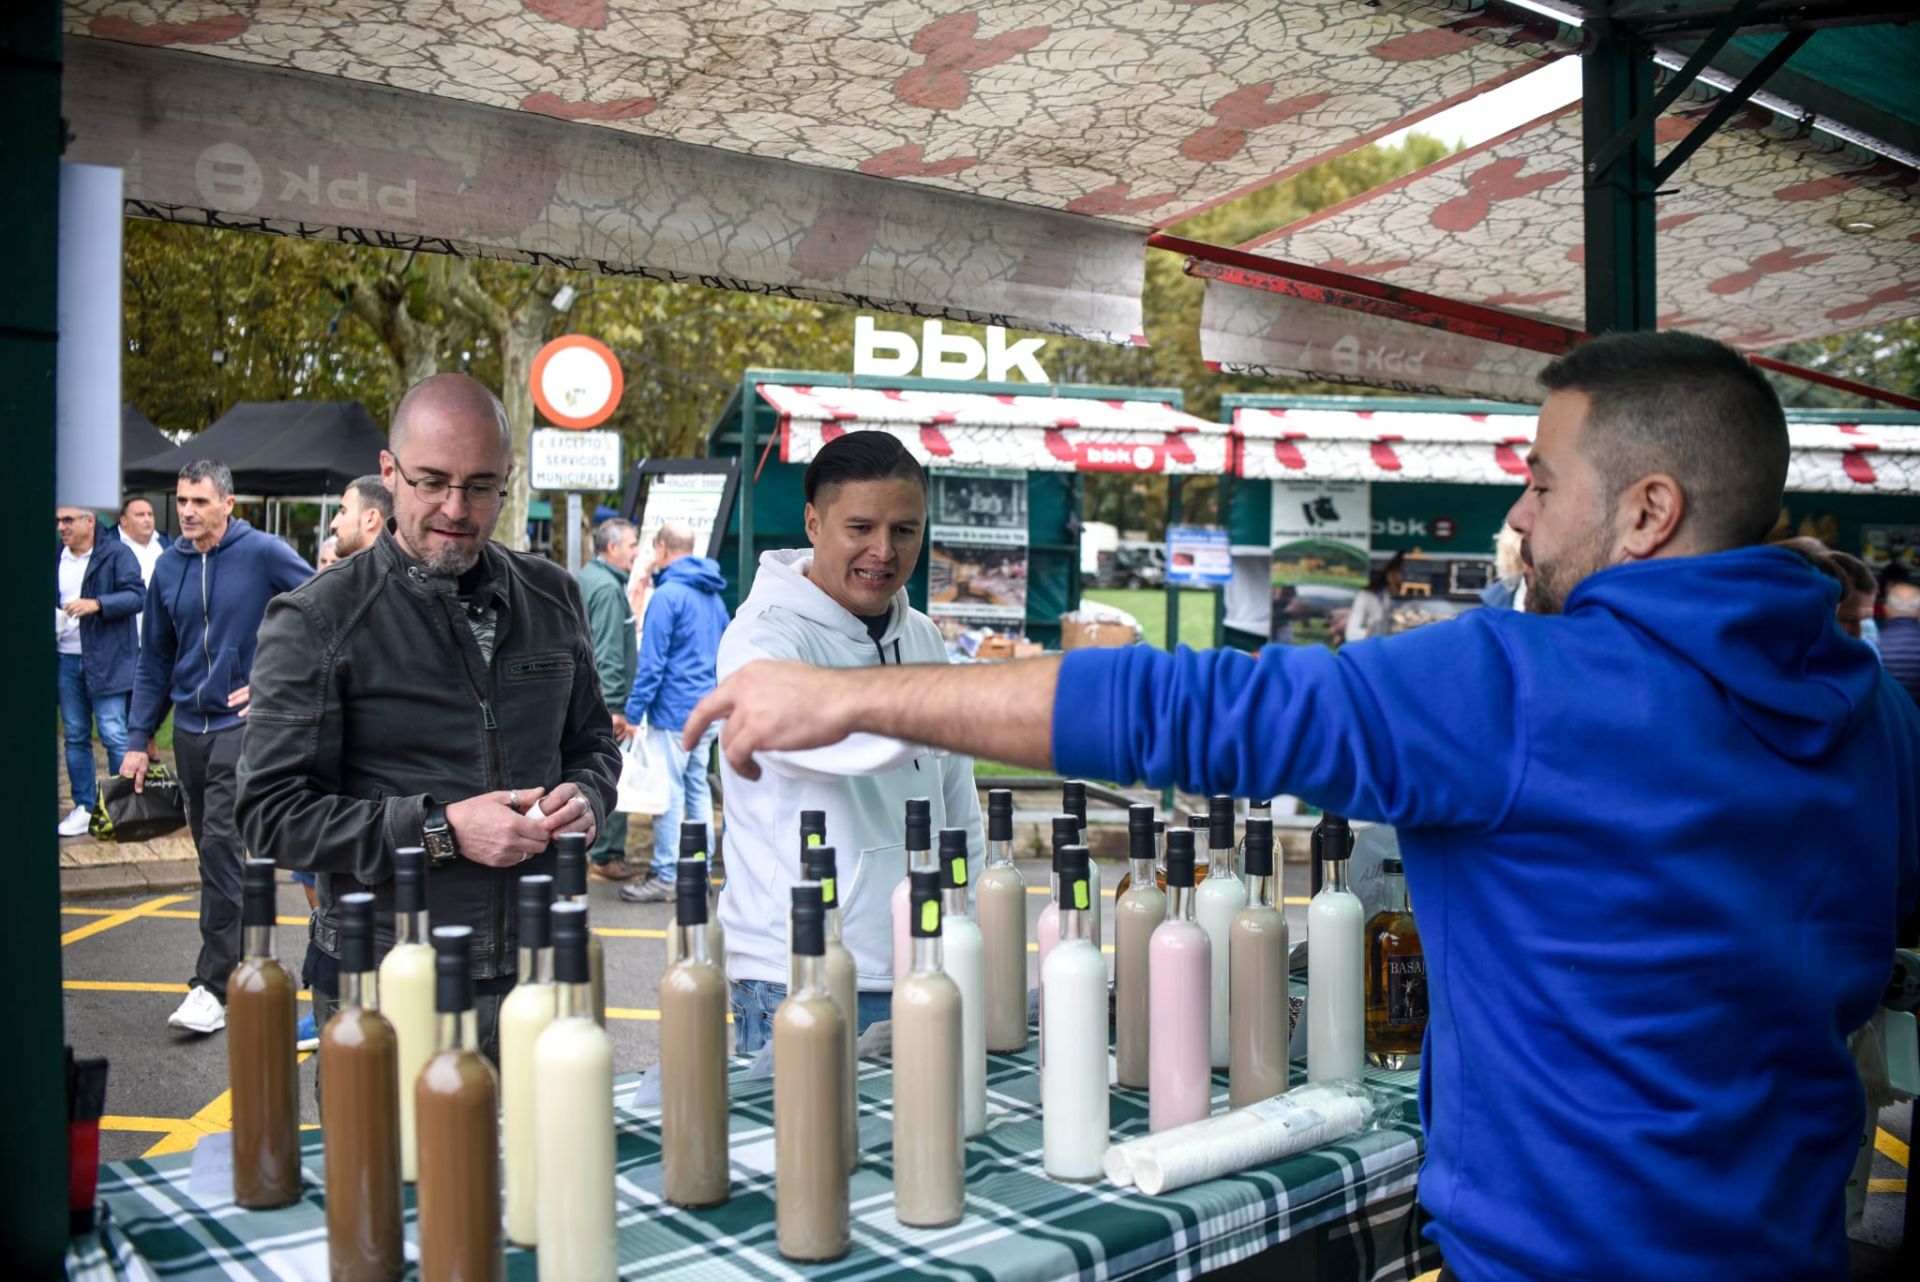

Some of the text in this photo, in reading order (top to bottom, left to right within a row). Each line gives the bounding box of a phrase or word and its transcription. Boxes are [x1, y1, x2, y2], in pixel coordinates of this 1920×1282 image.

[853, 315, 1050, 384] bbk
[550, 437, 602, 449] EXCEPTO
[545, 454, 607, 467] SERVICIOS
[1086, 446, 1131, 464] bbk
[536, 471, 615, 486] MUNICIPALES
